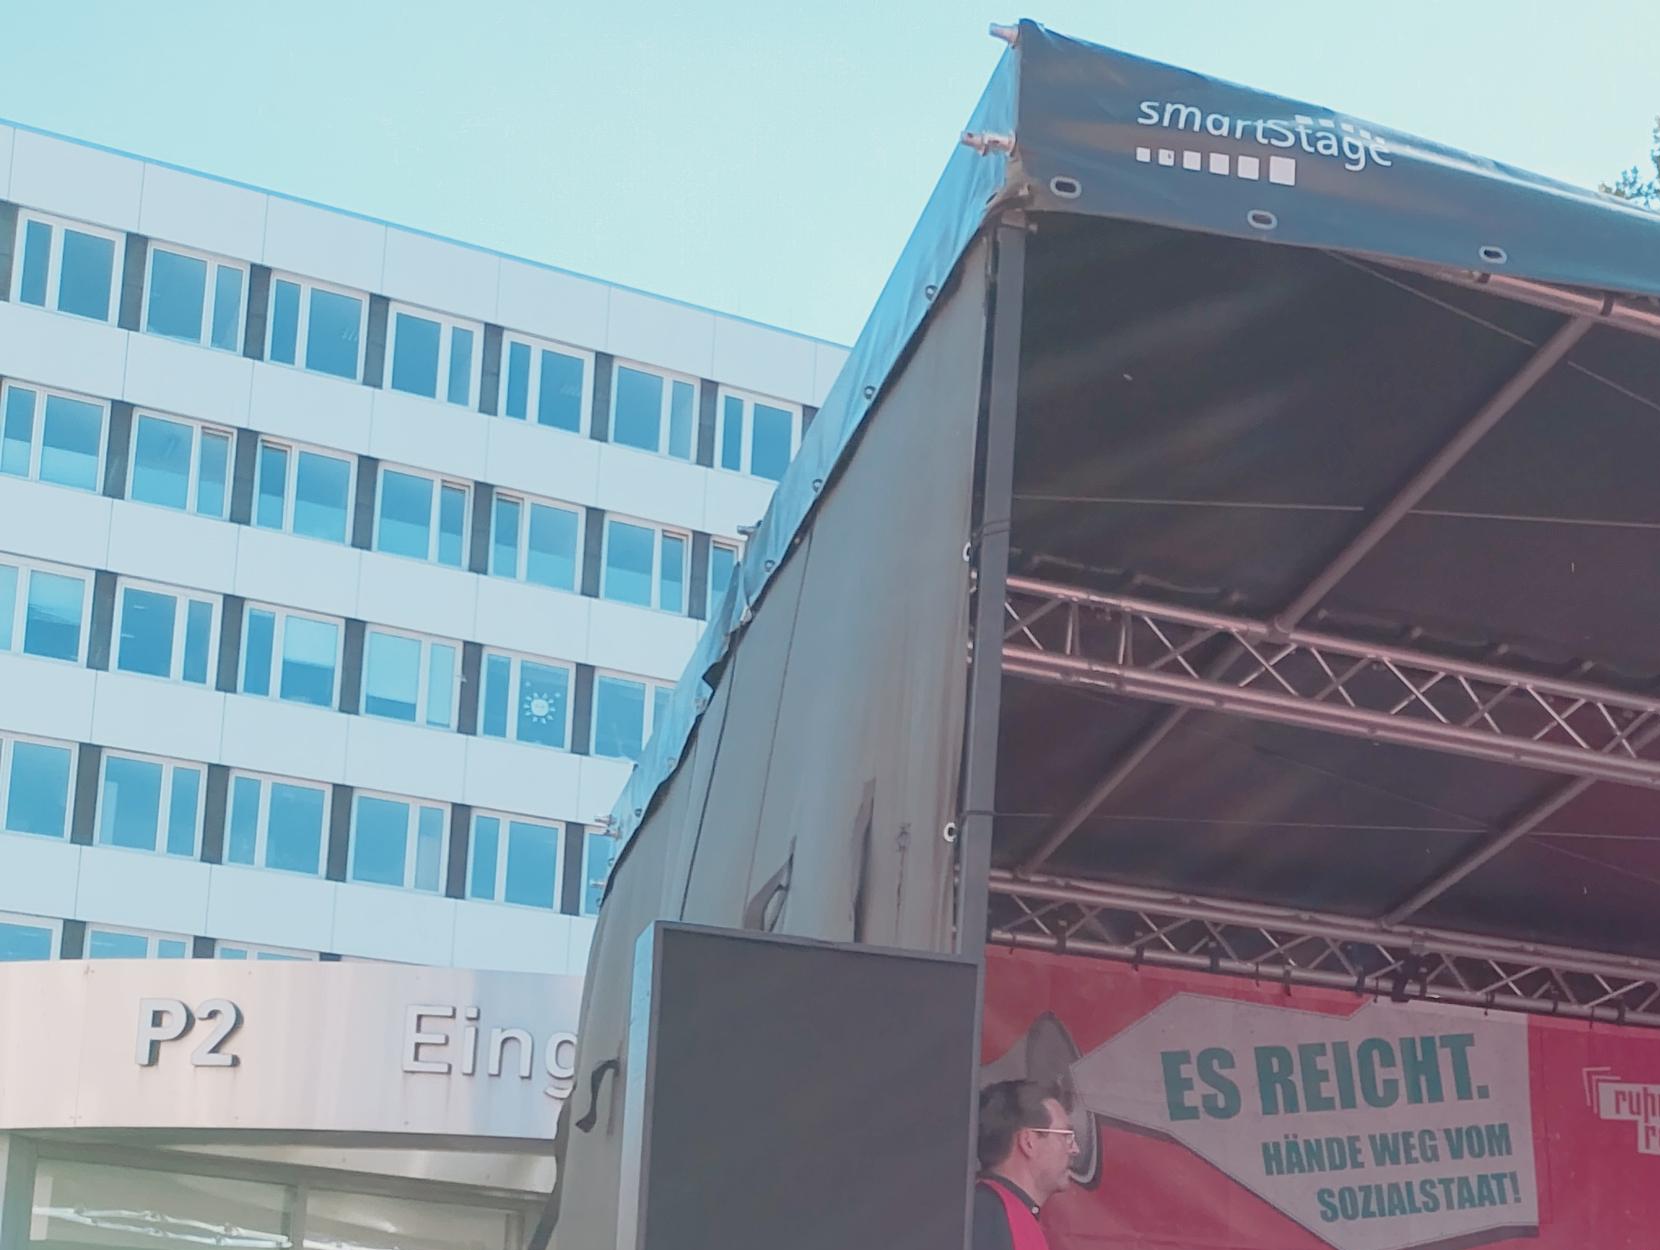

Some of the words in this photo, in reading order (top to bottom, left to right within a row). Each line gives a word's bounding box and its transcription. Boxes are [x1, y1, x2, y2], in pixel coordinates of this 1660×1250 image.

[1137, 99, 1393, 172] smartStage
[135, 997, 244, 1068] P2
[1160, 1047, 1243, 1122] ES
[1254, 1032, 1490, 1116] REICHT.
[1261, 1133, 1366, 1176] HÄNDE
[1368, 1130, 1440, 1168] WEG
[1443, 1122, 1513, 1161] VOM
[1316, 1171, 1523, 1223] SOZIALSTAAT!
